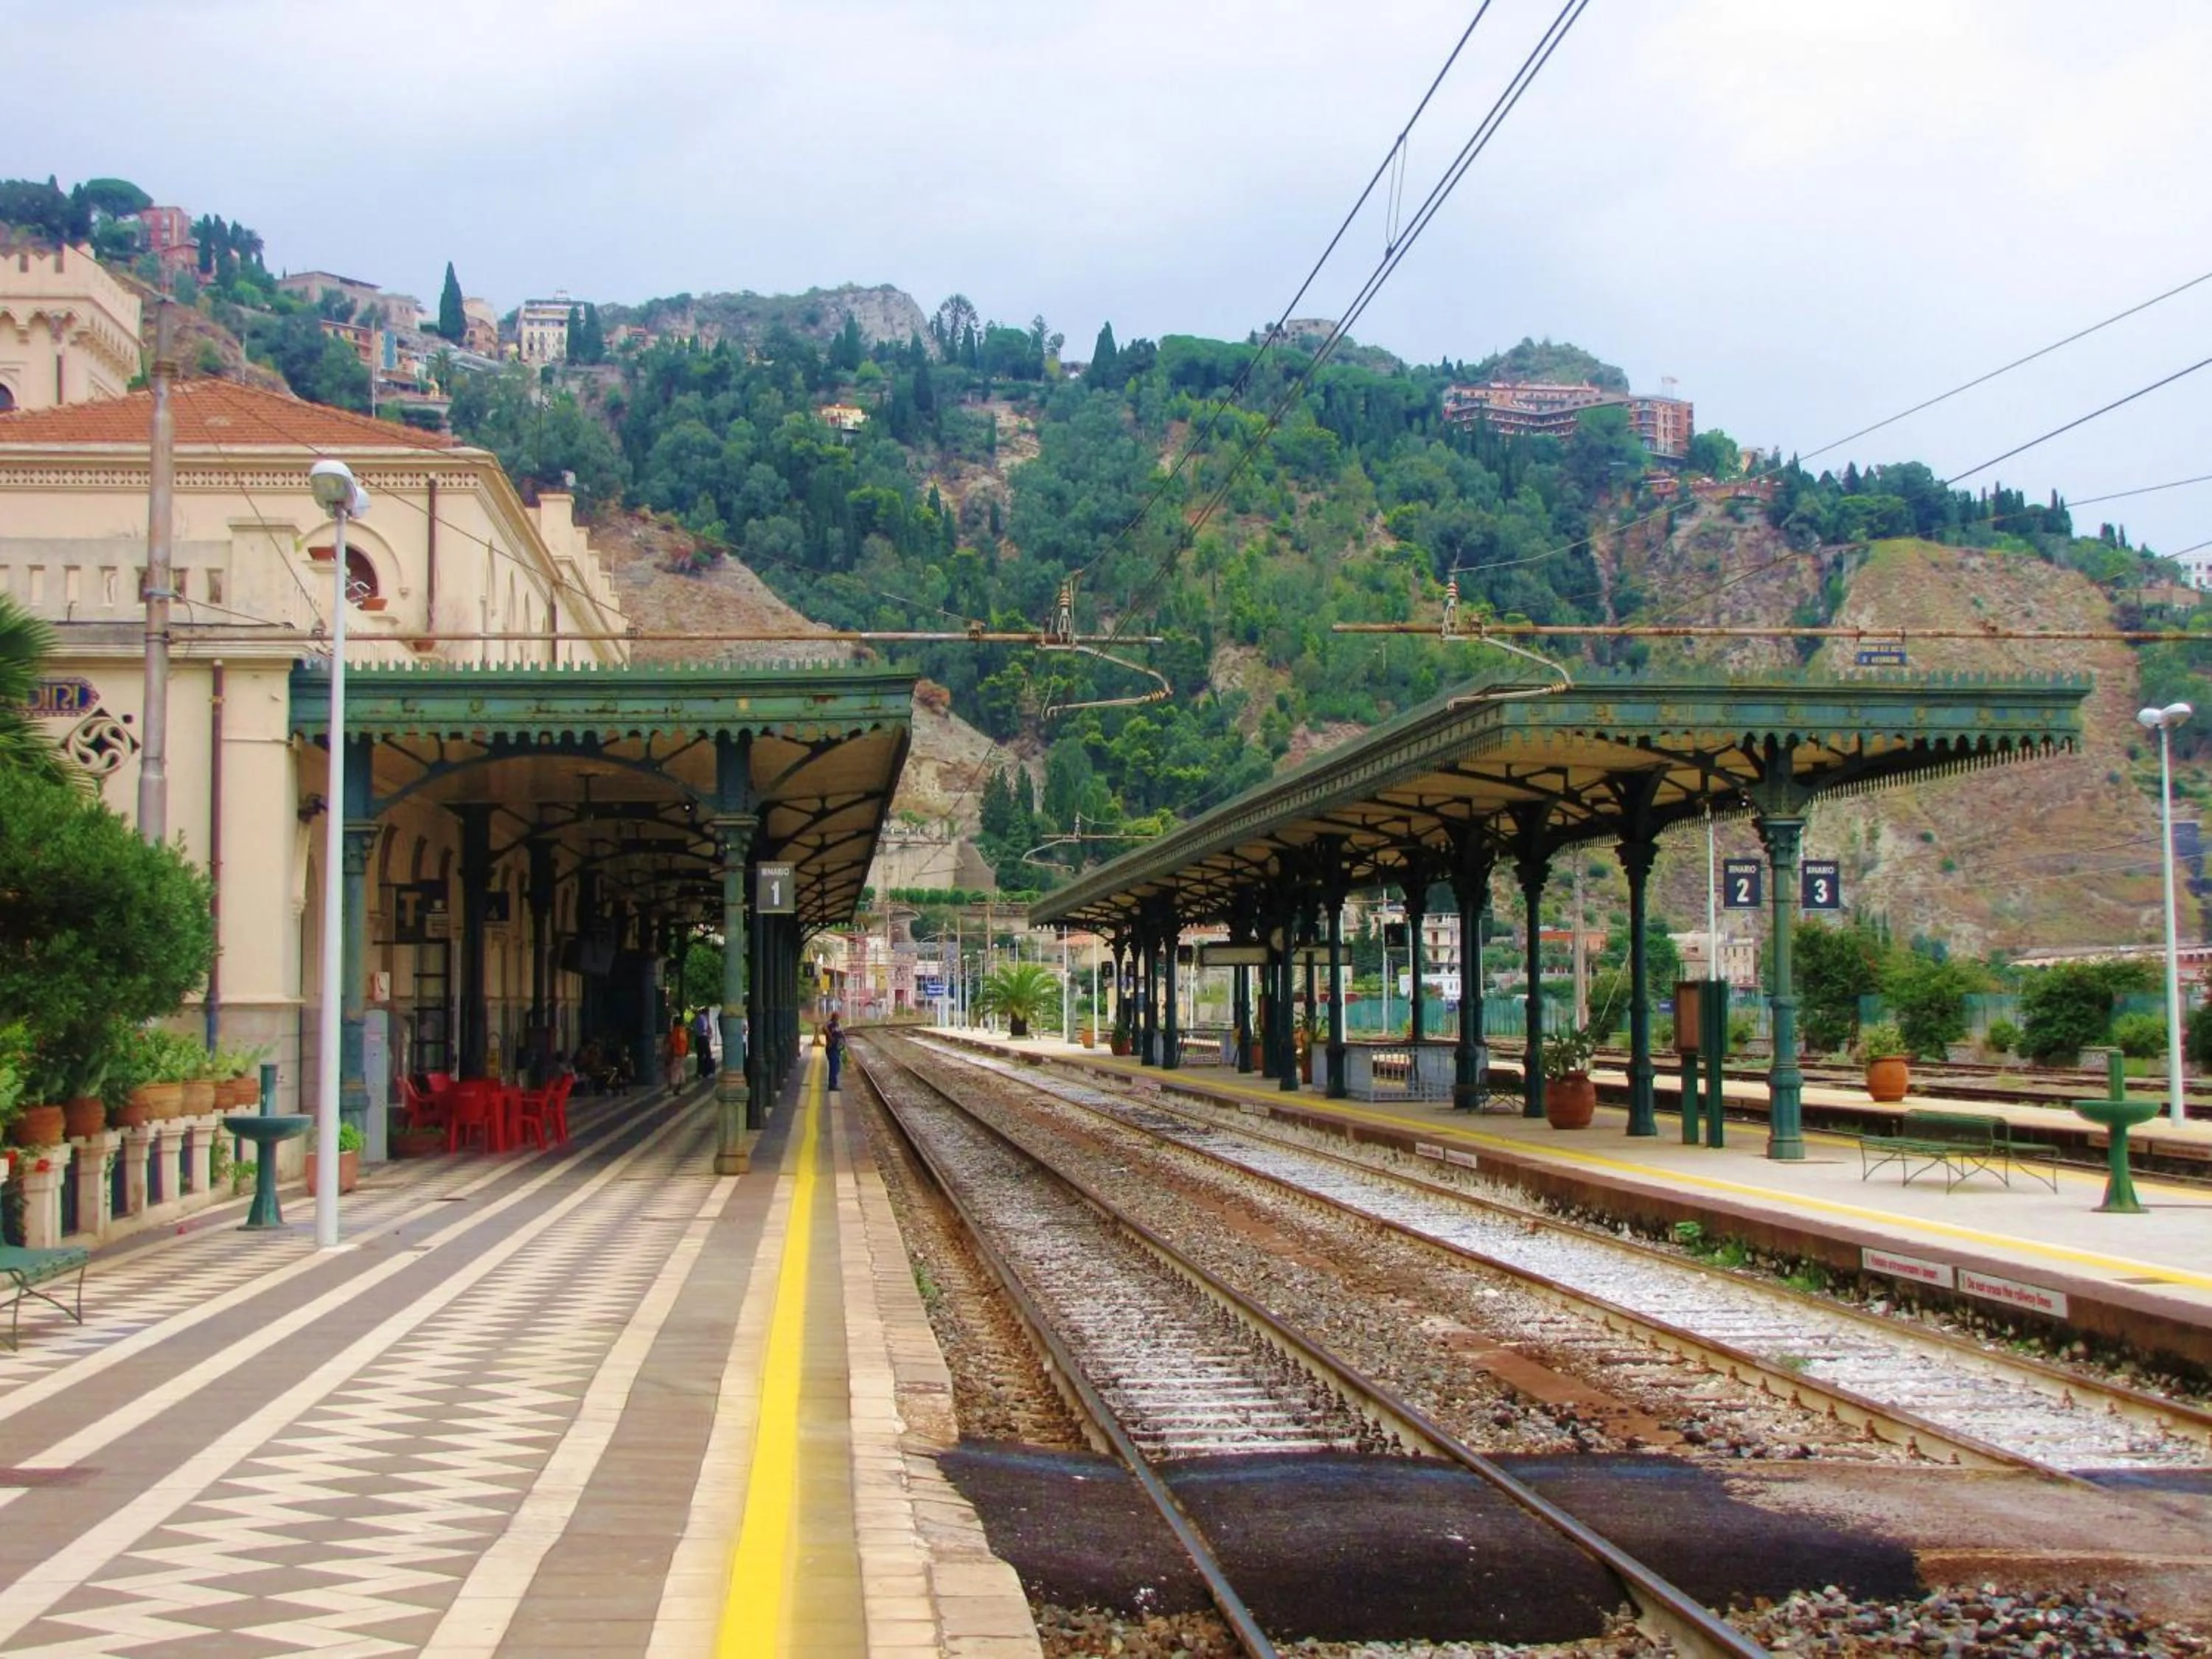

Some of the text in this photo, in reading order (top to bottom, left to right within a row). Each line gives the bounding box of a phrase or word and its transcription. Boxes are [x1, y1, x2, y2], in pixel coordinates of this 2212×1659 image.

[1728, 865, 1757, 874] BINARIO
[1806, 866, 1834, 874] BINARIO
[771, 880, 779, 906] 1
[1736, 878, 1750, 903] 2
[1814, 878, 1829, 903] 3
[400, 891, 422, 926] T
